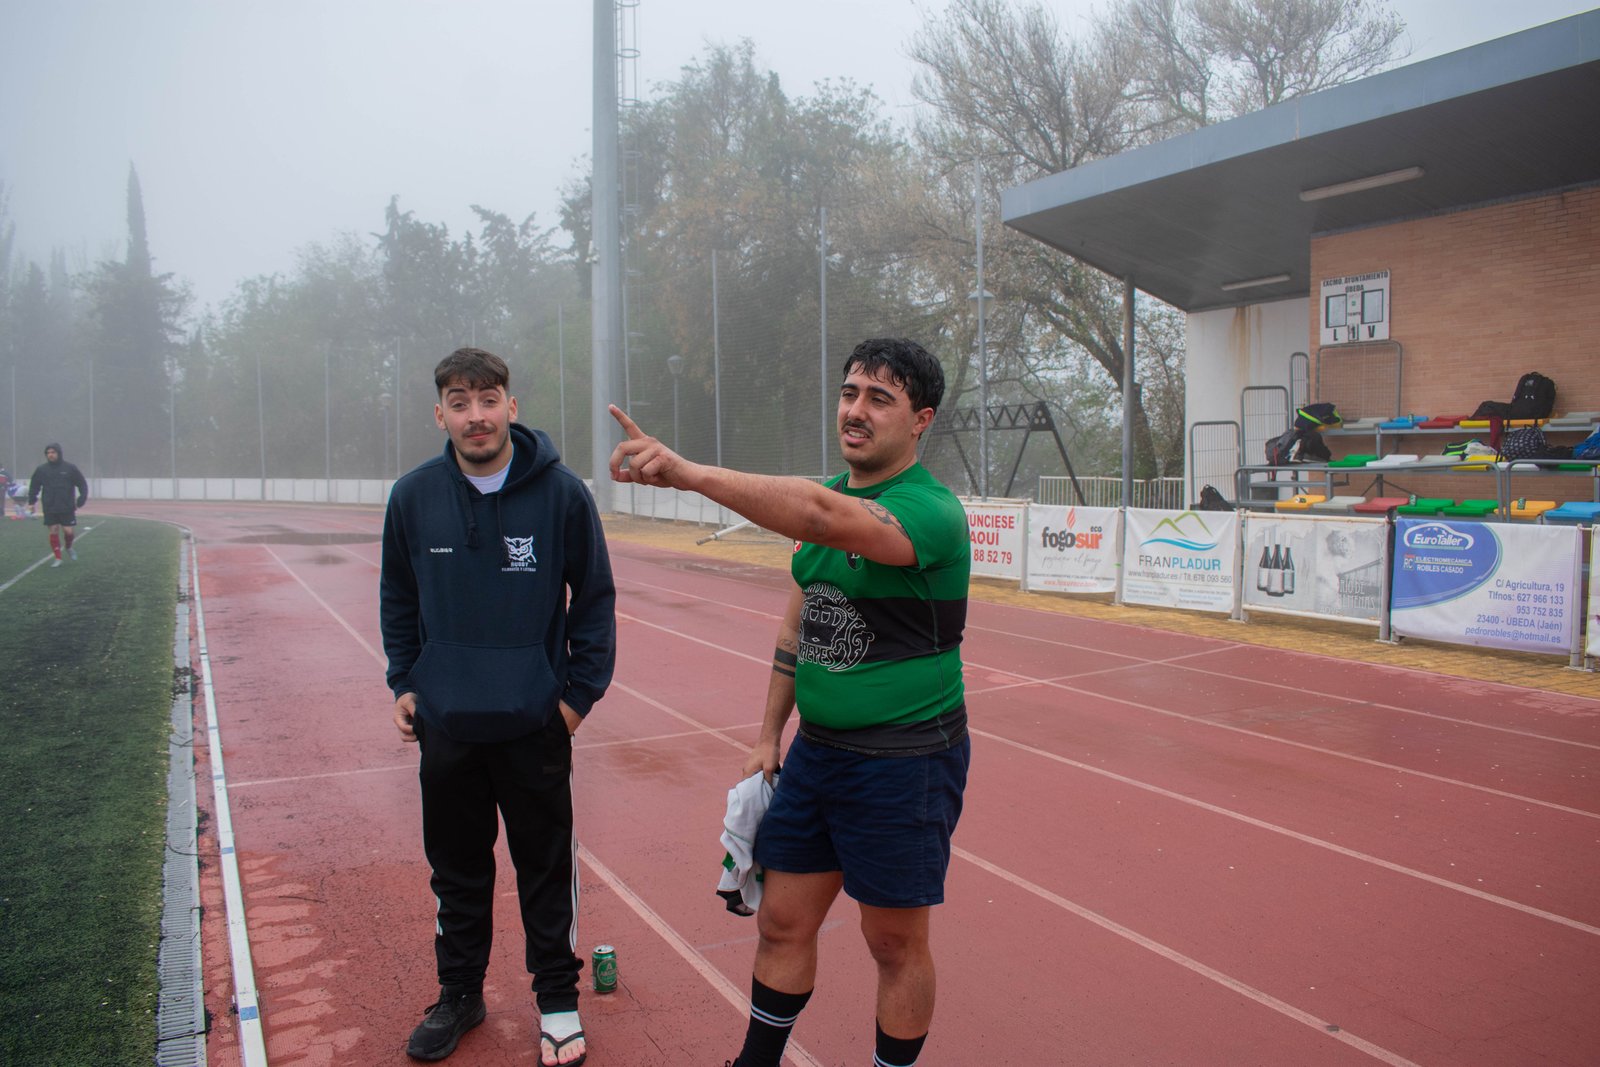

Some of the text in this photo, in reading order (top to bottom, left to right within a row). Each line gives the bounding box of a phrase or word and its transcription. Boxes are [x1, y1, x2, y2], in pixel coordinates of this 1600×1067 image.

[1344, 271, 1388, 283] AYUNTAMIENTO
[1334, 329, 1338, 341] L
[1368, 325, 1375, 338] V
[968, 511, 1015, 530] ÚNCIESE
[1090, 525, 1103, 533] eco
[1042, 526, 1103, 552] fogosur
[1413, 533, 1462, 546] EuroTaller
[973, 549, 1012, 565] 88 52 79
[1138, 555, 1221, 571] FRANPLADUR
[1440, 565, 1464, 574] CASADO
[1505, 580, 1553, 592] Agricultura,
[1555, 583, 1564, 593] 19
[1516, 592, 1531, 602] 627
[1533, 593, 1548, 603] 966
[1550, 595, 1564, 605] 133
[1516, 605, 1531, 615] 953
[1532, 606, 1547, 616] 752
[1477, 614, 1500, 625] 23400
[1537, 618, 1563, 632] (Jaén)
[1465, 627, 1561, 643] pedrorobles@hotmail.es
